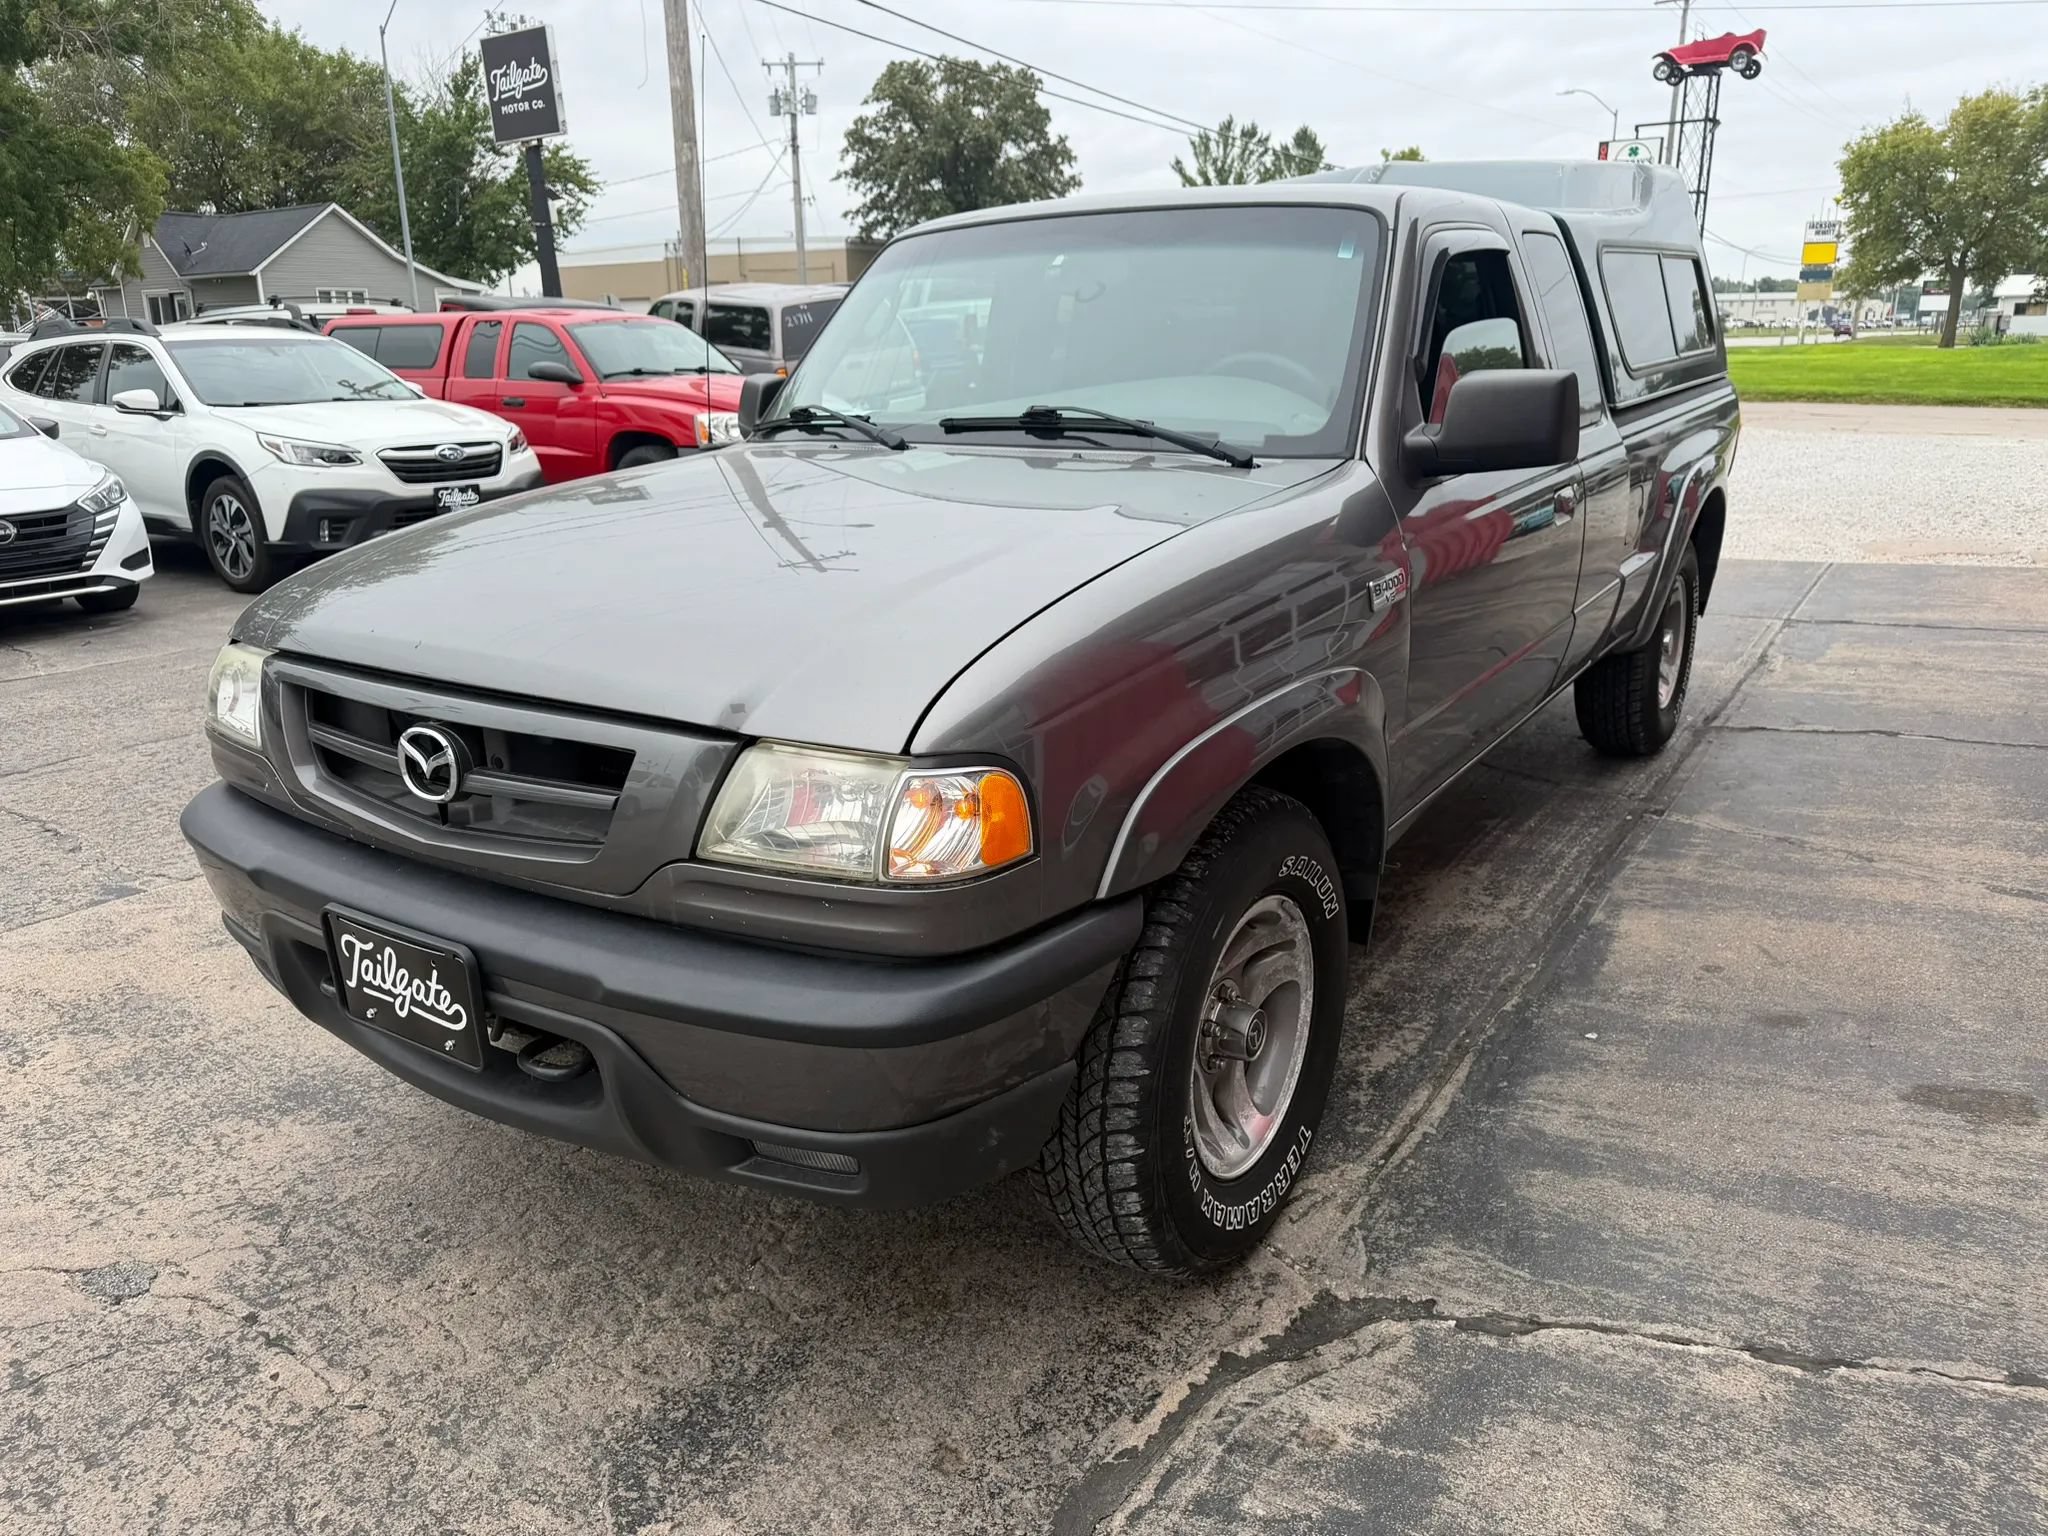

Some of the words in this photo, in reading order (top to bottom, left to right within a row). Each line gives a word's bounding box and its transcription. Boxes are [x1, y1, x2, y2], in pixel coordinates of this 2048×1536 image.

[490, 56, 548, 102] Tailgate
[501, 101, 530, 115] MOTOR
[1808, 222, 1836, 230] JACKSON
[438, 487, 480, 507] Tailgate
[1374, 572, 1405, 597] B4000
[1278, 855, 1340, 920] SAILUN
[340, 933, 468, 1031] Tailgate
[1200, 1124, 1313, 1231] TERRAMAX
